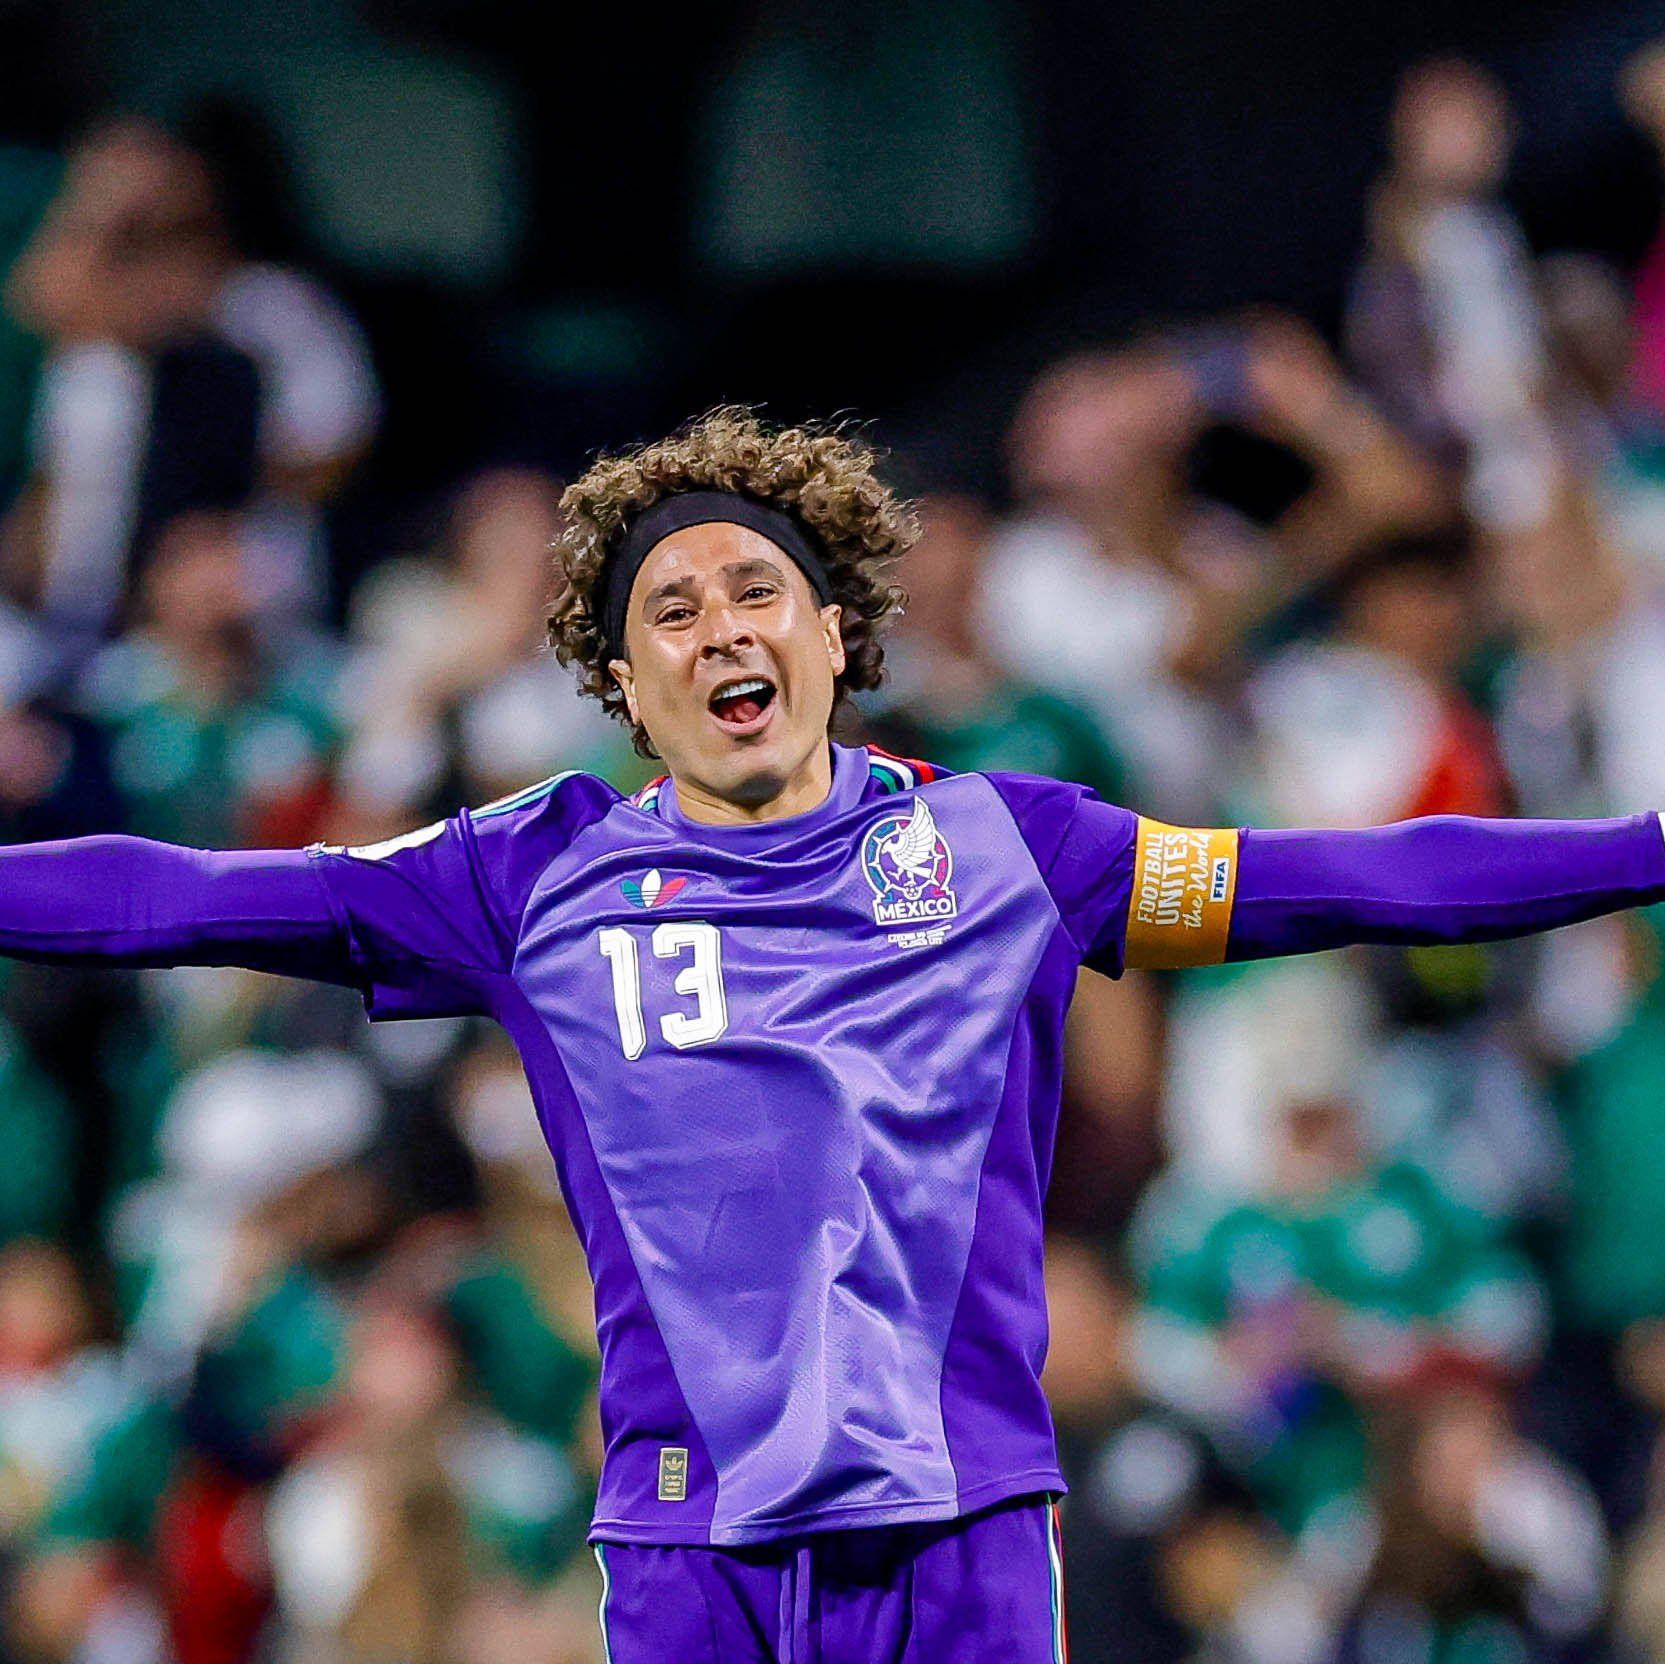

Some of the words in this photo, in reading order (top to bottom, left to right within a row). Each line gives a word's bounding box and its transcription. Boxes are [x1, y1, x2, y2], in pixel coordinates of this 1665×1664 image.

[1138, 832, 1164, 923] FOOTBALL
[1155, 833, 1188, 925] UNITES
[1187, 832, 1213, 891] World
[1213, 861, 1226, 898] FIFA
[878, 898, 952, 920] MÉXICO
[1183, 894, 1203, 930] the
[598, 921, 729, 1061] 13
